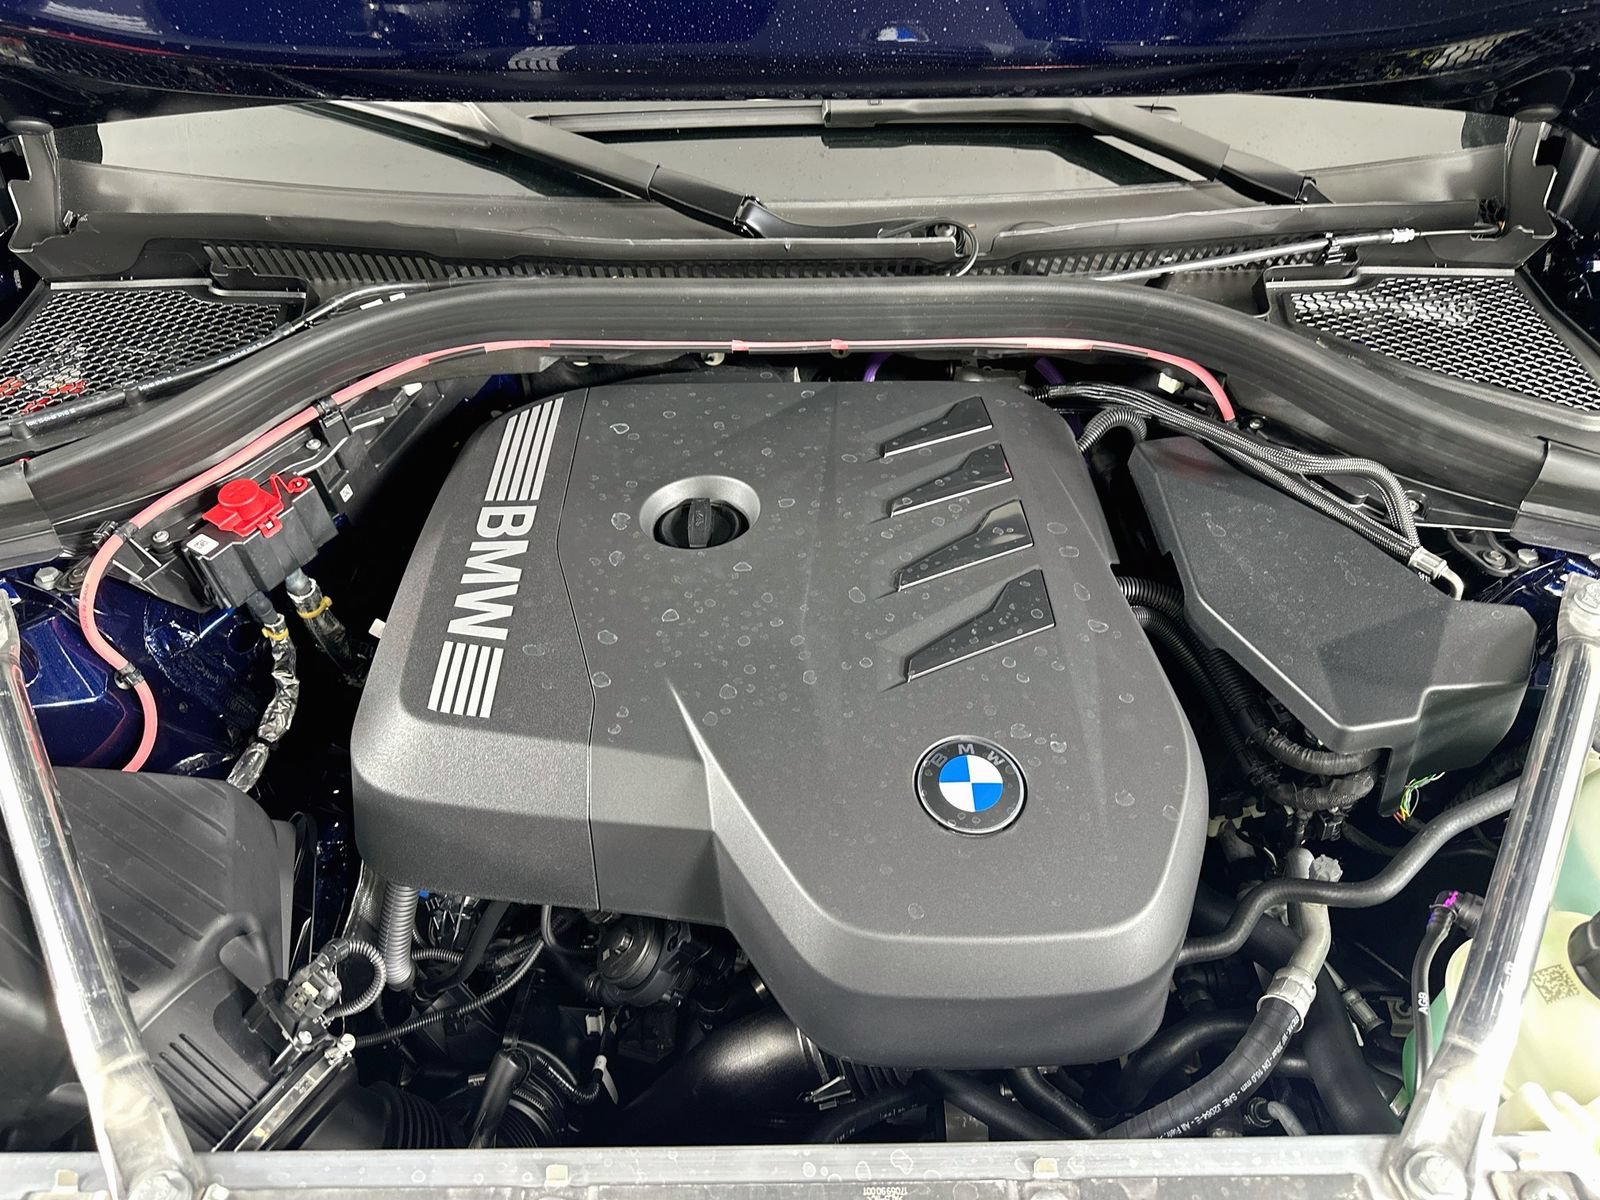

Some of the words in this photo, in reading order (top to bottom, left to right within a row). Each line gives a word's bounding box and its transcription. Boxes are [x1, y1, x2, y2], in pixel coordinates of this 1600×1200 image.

[447, 505, 538, 640] BMW
[931, 743, 1005, 768] BMW
[1418, 991, 1429, 1016] AGB
[1222, 1092, 1238, 1108] SAE
